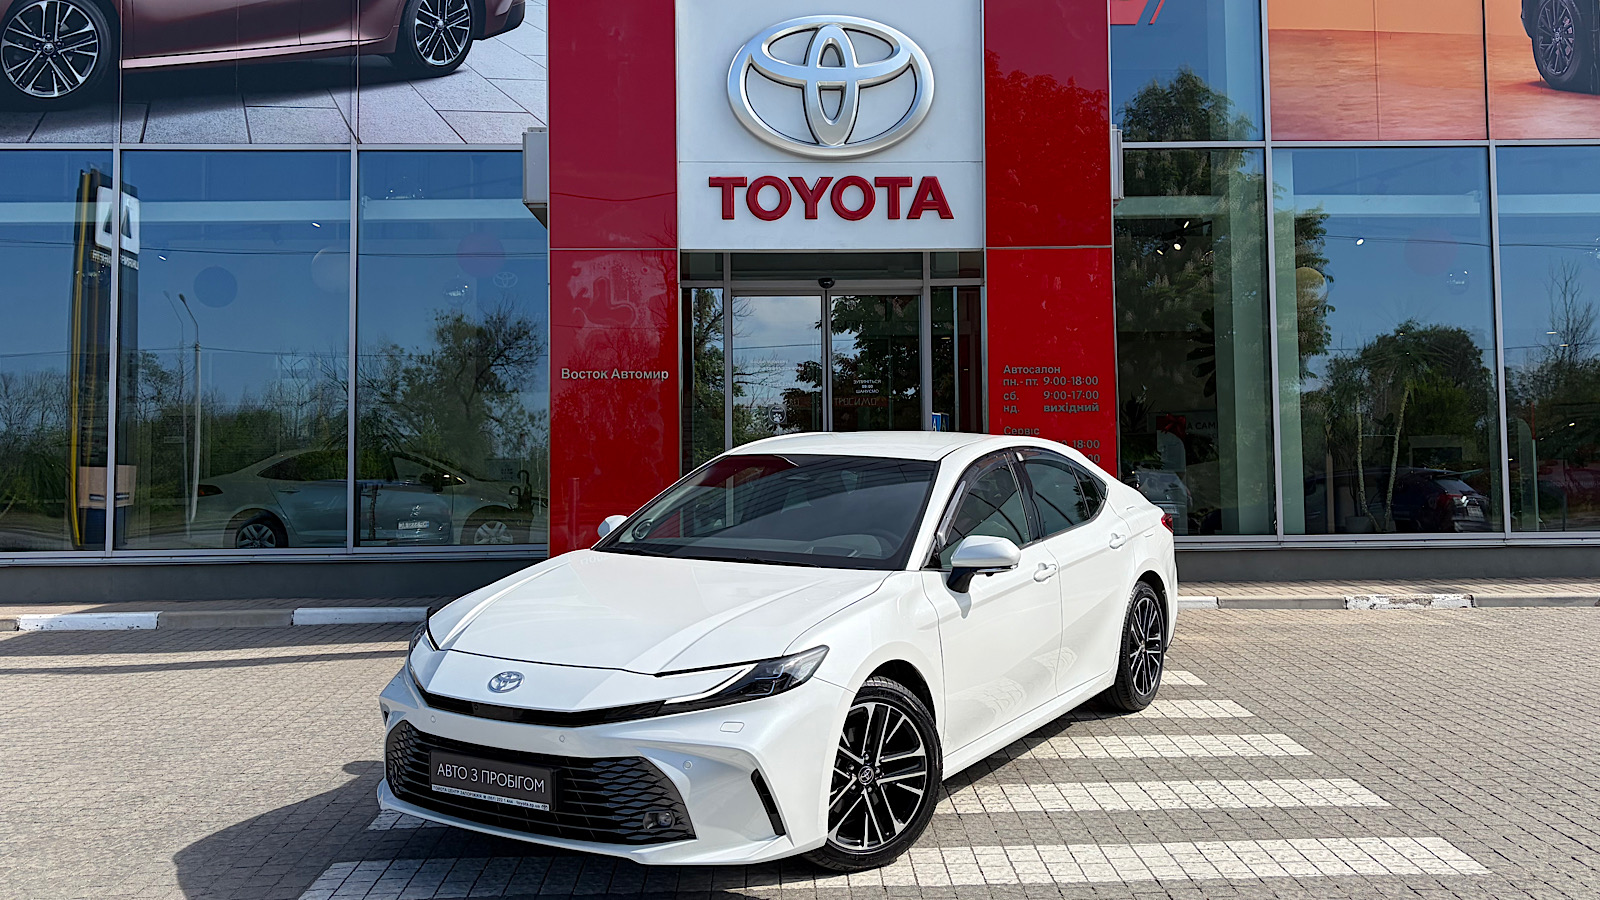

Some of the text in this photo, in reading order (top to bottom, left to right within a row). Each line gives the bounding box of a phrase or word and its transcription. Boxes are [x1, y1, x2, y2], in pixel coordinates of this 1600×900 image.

[709, 176, 954, 221] TOYOTA
[561, 368, 669, 382] Восток Автомир
[1003, 365, 1061, 374] Автосалон
[1003, 391, 1099, 401] сб. 9:00-17:00
[1003, 402, 1099, 414] нд. вихідний
[1004, 426, 1040, 435] Сервіс
[437, 763, 545, 793] АВТО З ПРОБІГОМ
